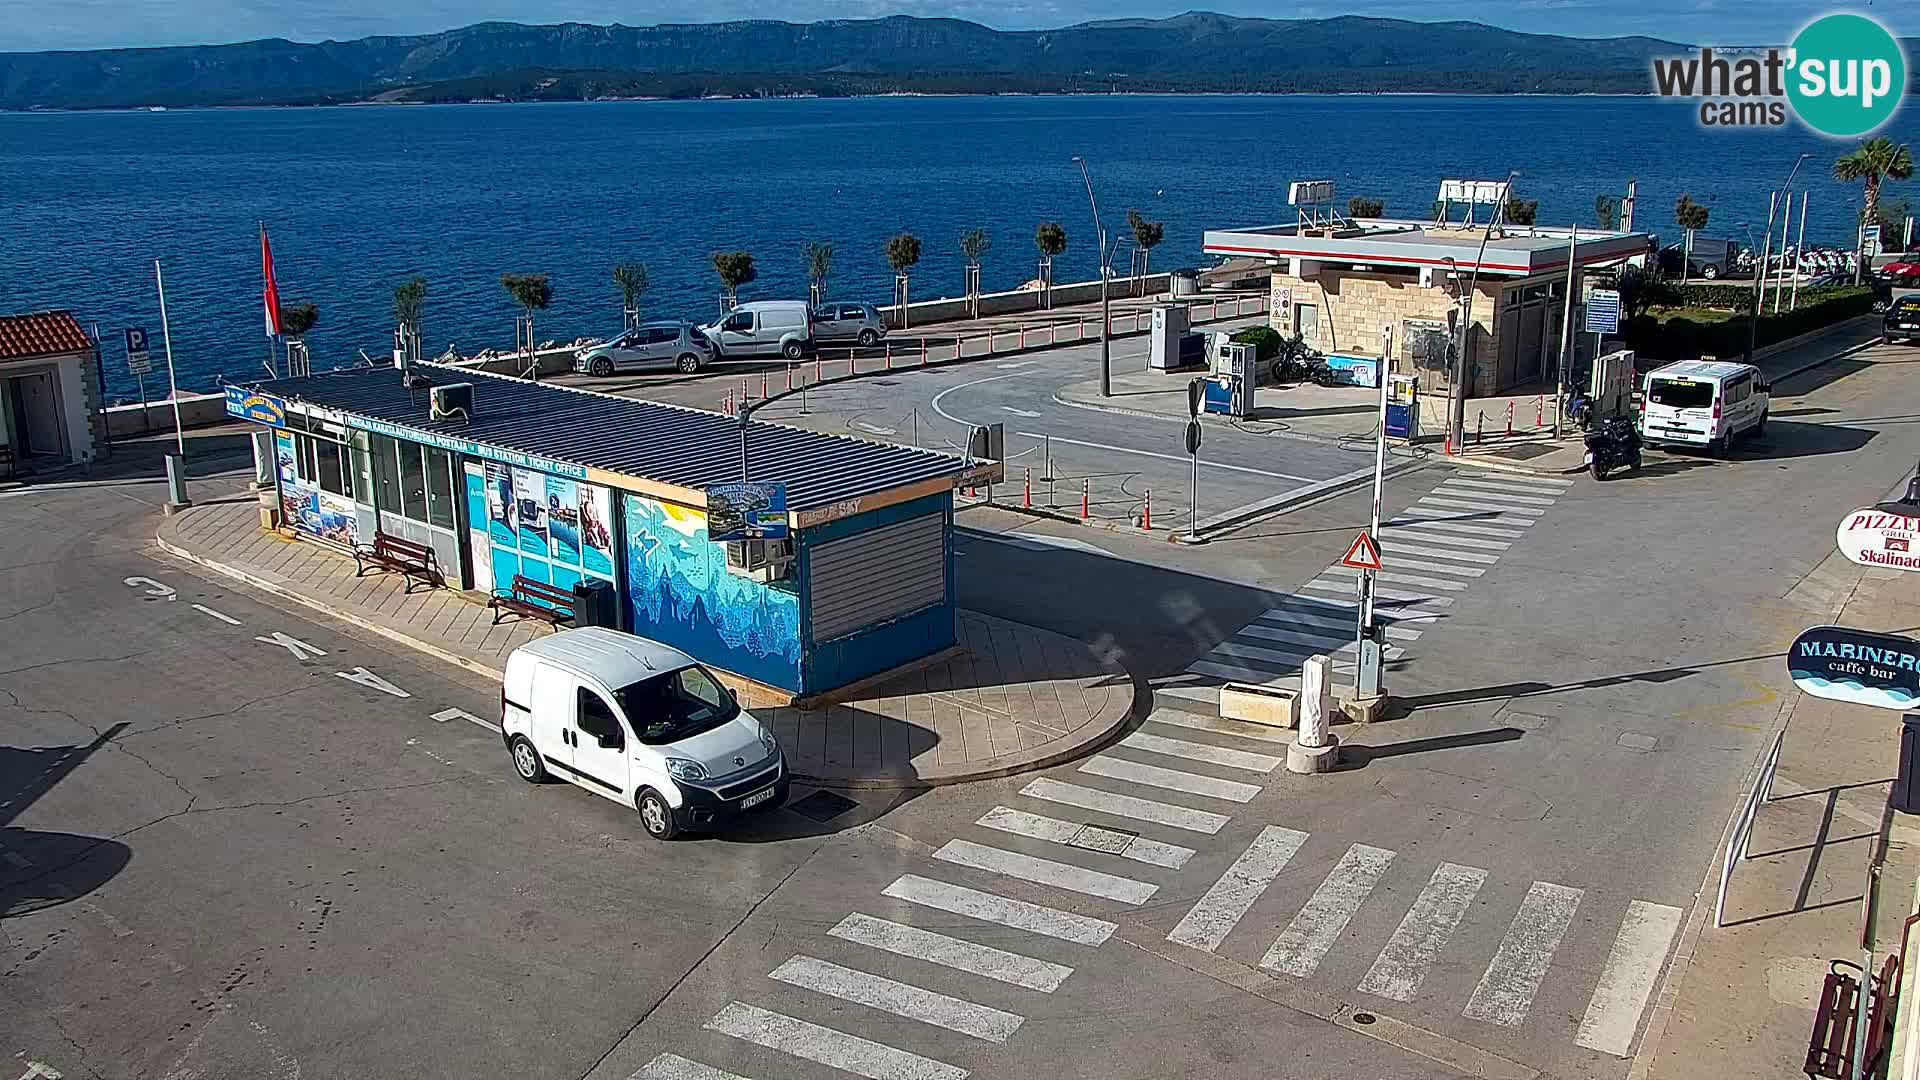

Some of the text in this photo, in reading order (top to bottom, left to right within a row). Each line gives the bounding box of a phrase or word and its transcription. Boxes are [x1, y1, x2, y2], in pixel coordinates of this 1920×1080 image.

[130, 331, 144, 349] P
[436, 437, 467, 452] POSTAJA
[477, 442, 493, 457] BUS
[494, 449, 526, 465] STATION
[527, 457, 554, 472] TICKET
[555, 464, 583, 477] OFFICE
[1881, 530, 1917, 539] GRILL
[1828, 661, 1897, 680] caffe bar
